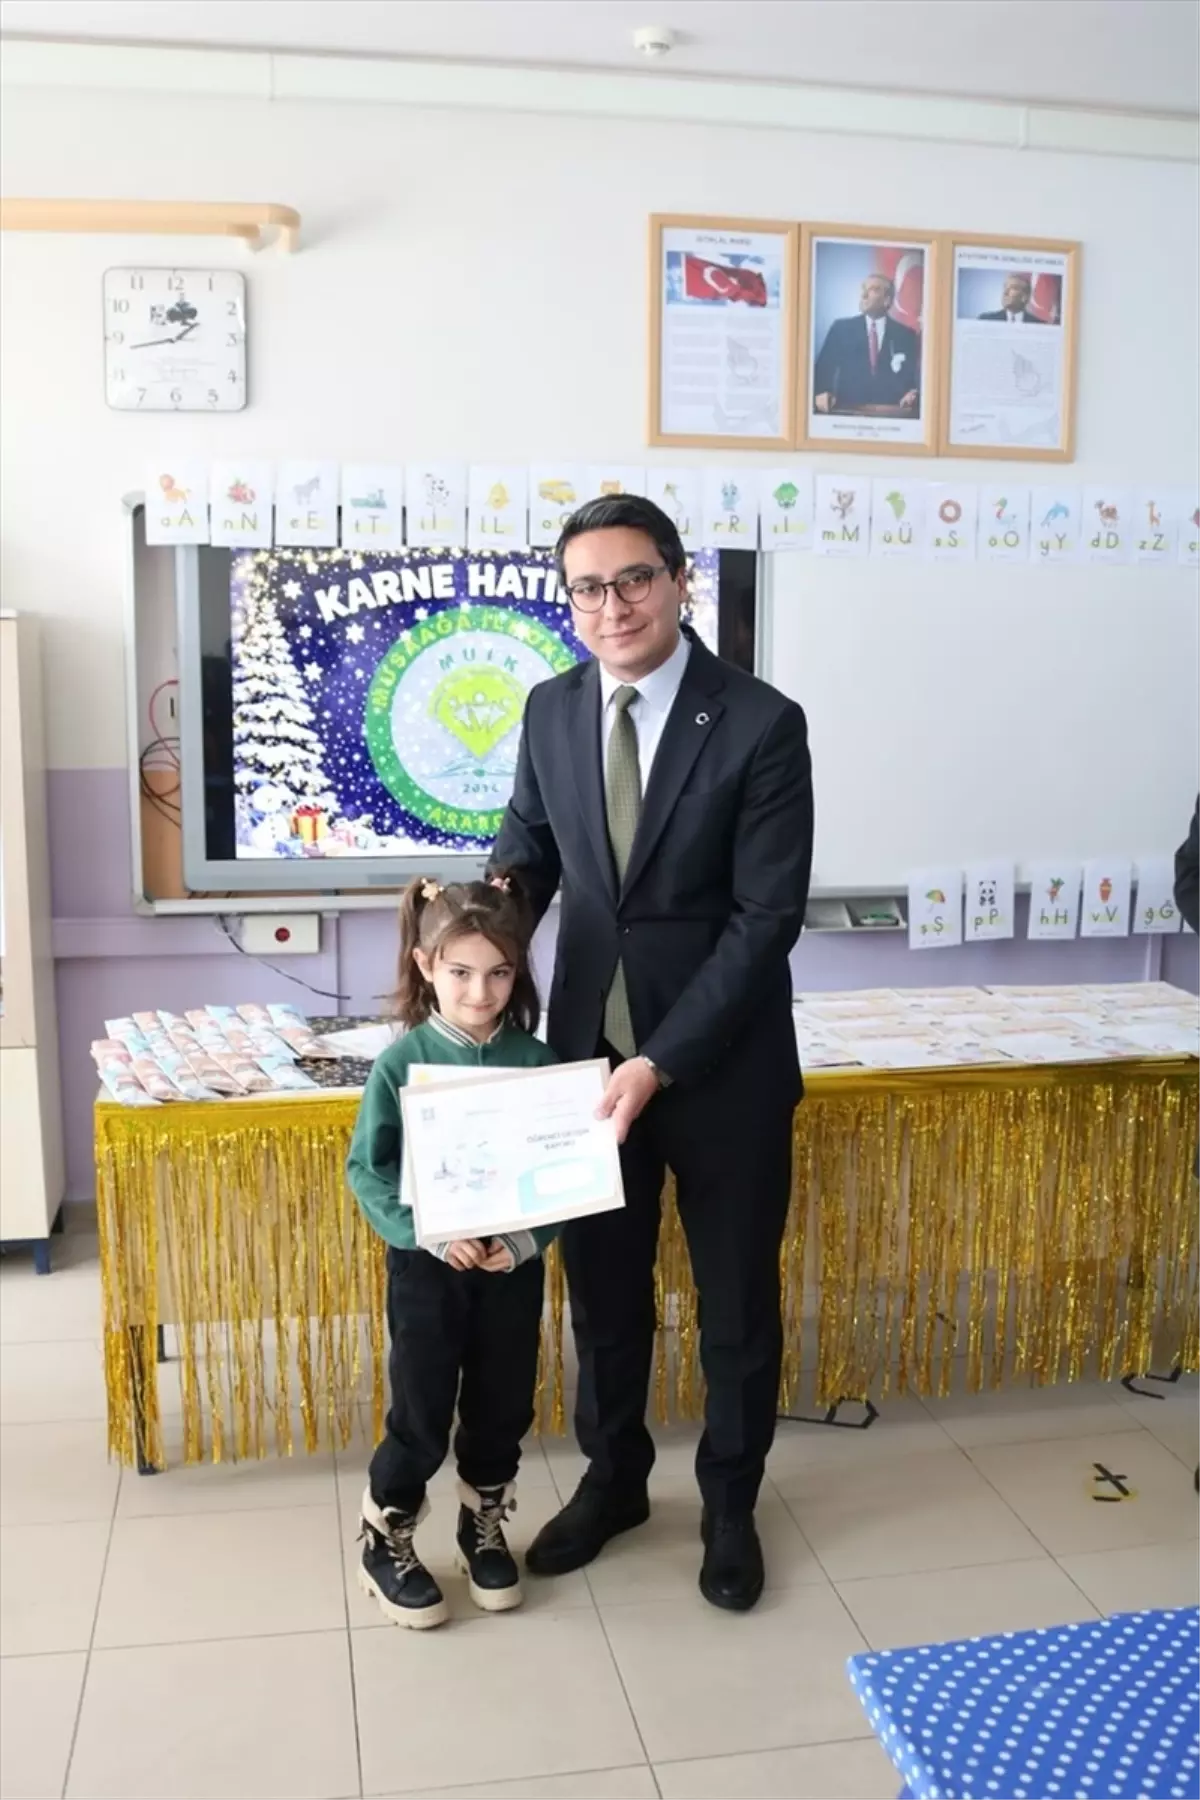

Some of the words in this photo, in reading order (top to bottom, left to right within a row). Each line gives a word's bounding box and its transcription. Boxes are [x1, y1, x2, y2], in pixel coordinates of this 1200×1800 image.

[130, 275, 144, 291] 11
[167, 276, 184, 291] 12
[113, 299, 129, 314] 10
[226, 301, 238, 316] 2
[112, 330, 124, 345] 9
[225, 333, 237, 347] 3
[227, 369, 238, 384] 4
[136, 386, 148, 402] 7
[170, 387, 182, 402] 6
[207, 388, 219, 403] 5
[315, 564, 456, 625] KARNE
